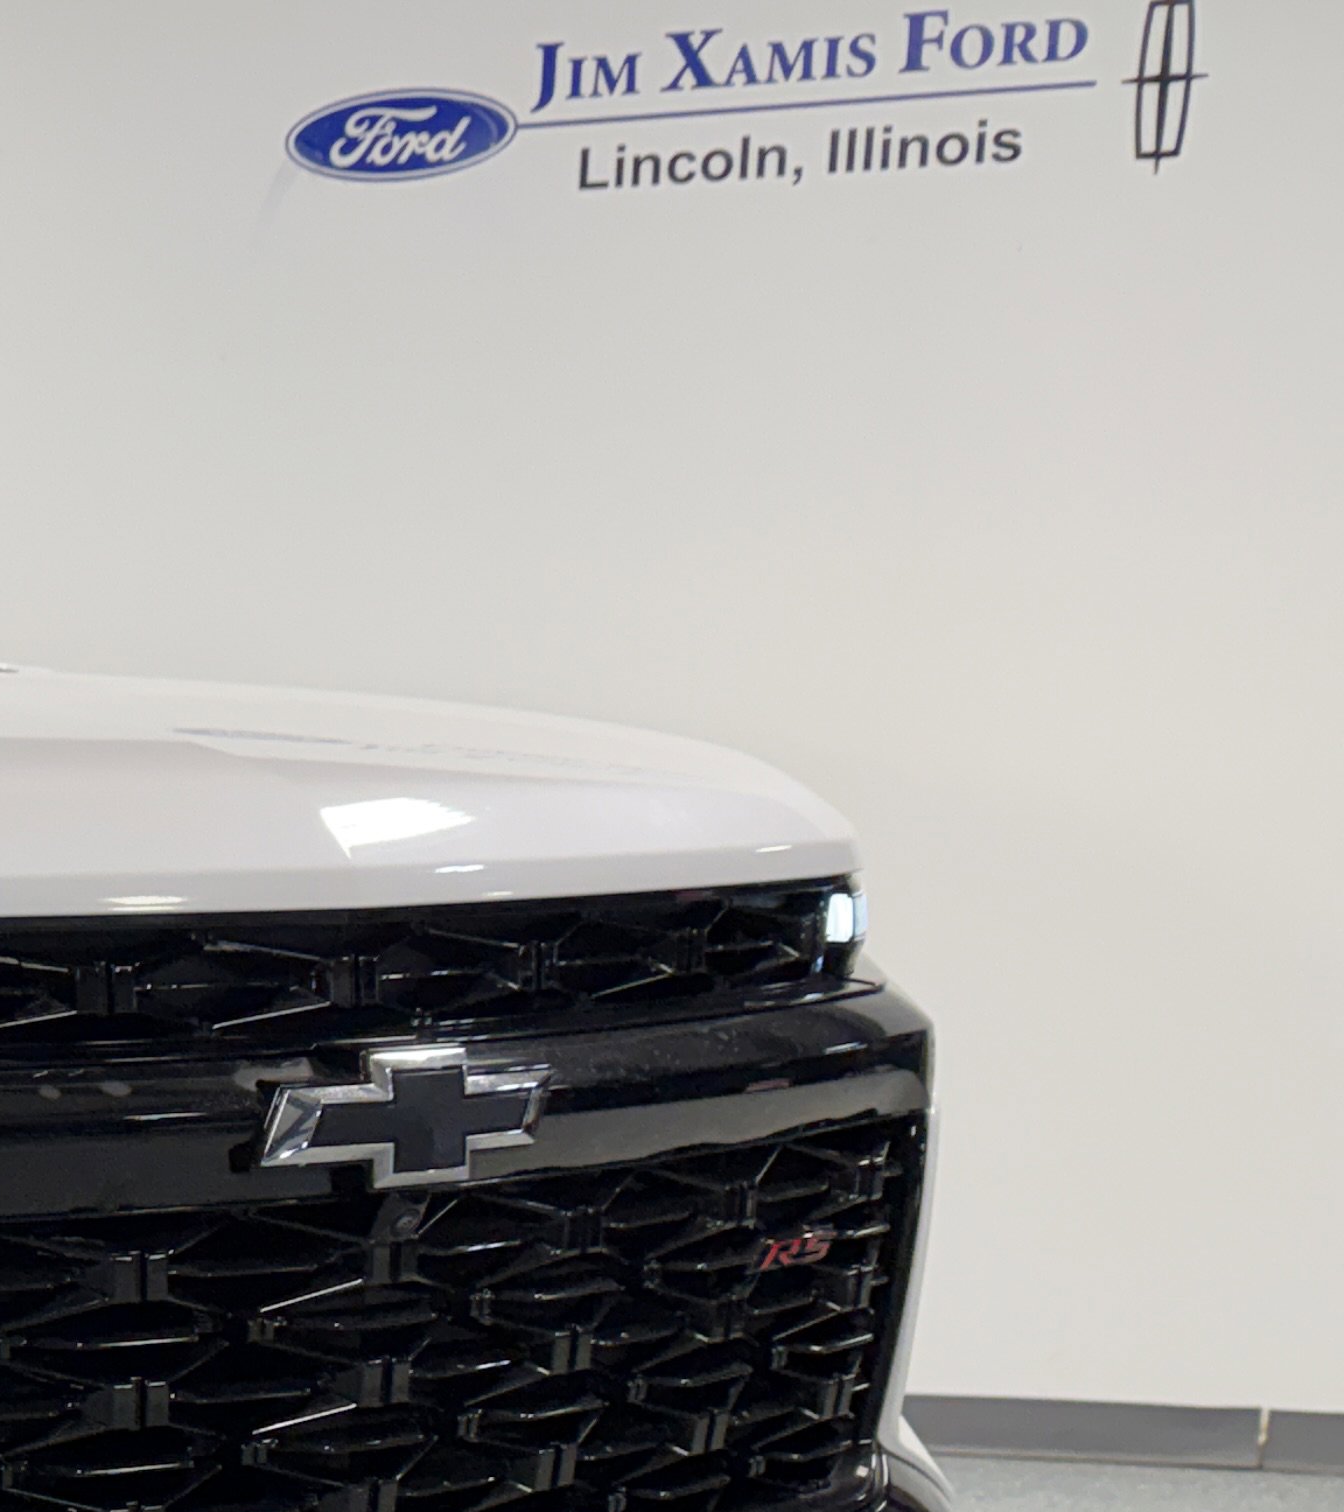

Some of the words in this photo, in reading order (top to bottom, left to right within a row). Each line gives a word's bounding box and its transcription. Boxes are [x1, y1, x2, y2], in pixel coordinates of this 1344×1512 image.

[530, 41, 642, 113] JIM
[660, 28, 877, 93] XAMIS
[898, 10, 1089, 74] FORD
[329, 104, 472, 169] Ford
[578, 134, 804, 190] Lincoln,
[827, 119, 1023, 174] Illinois
[760, 1230, 838, 1271] RS
